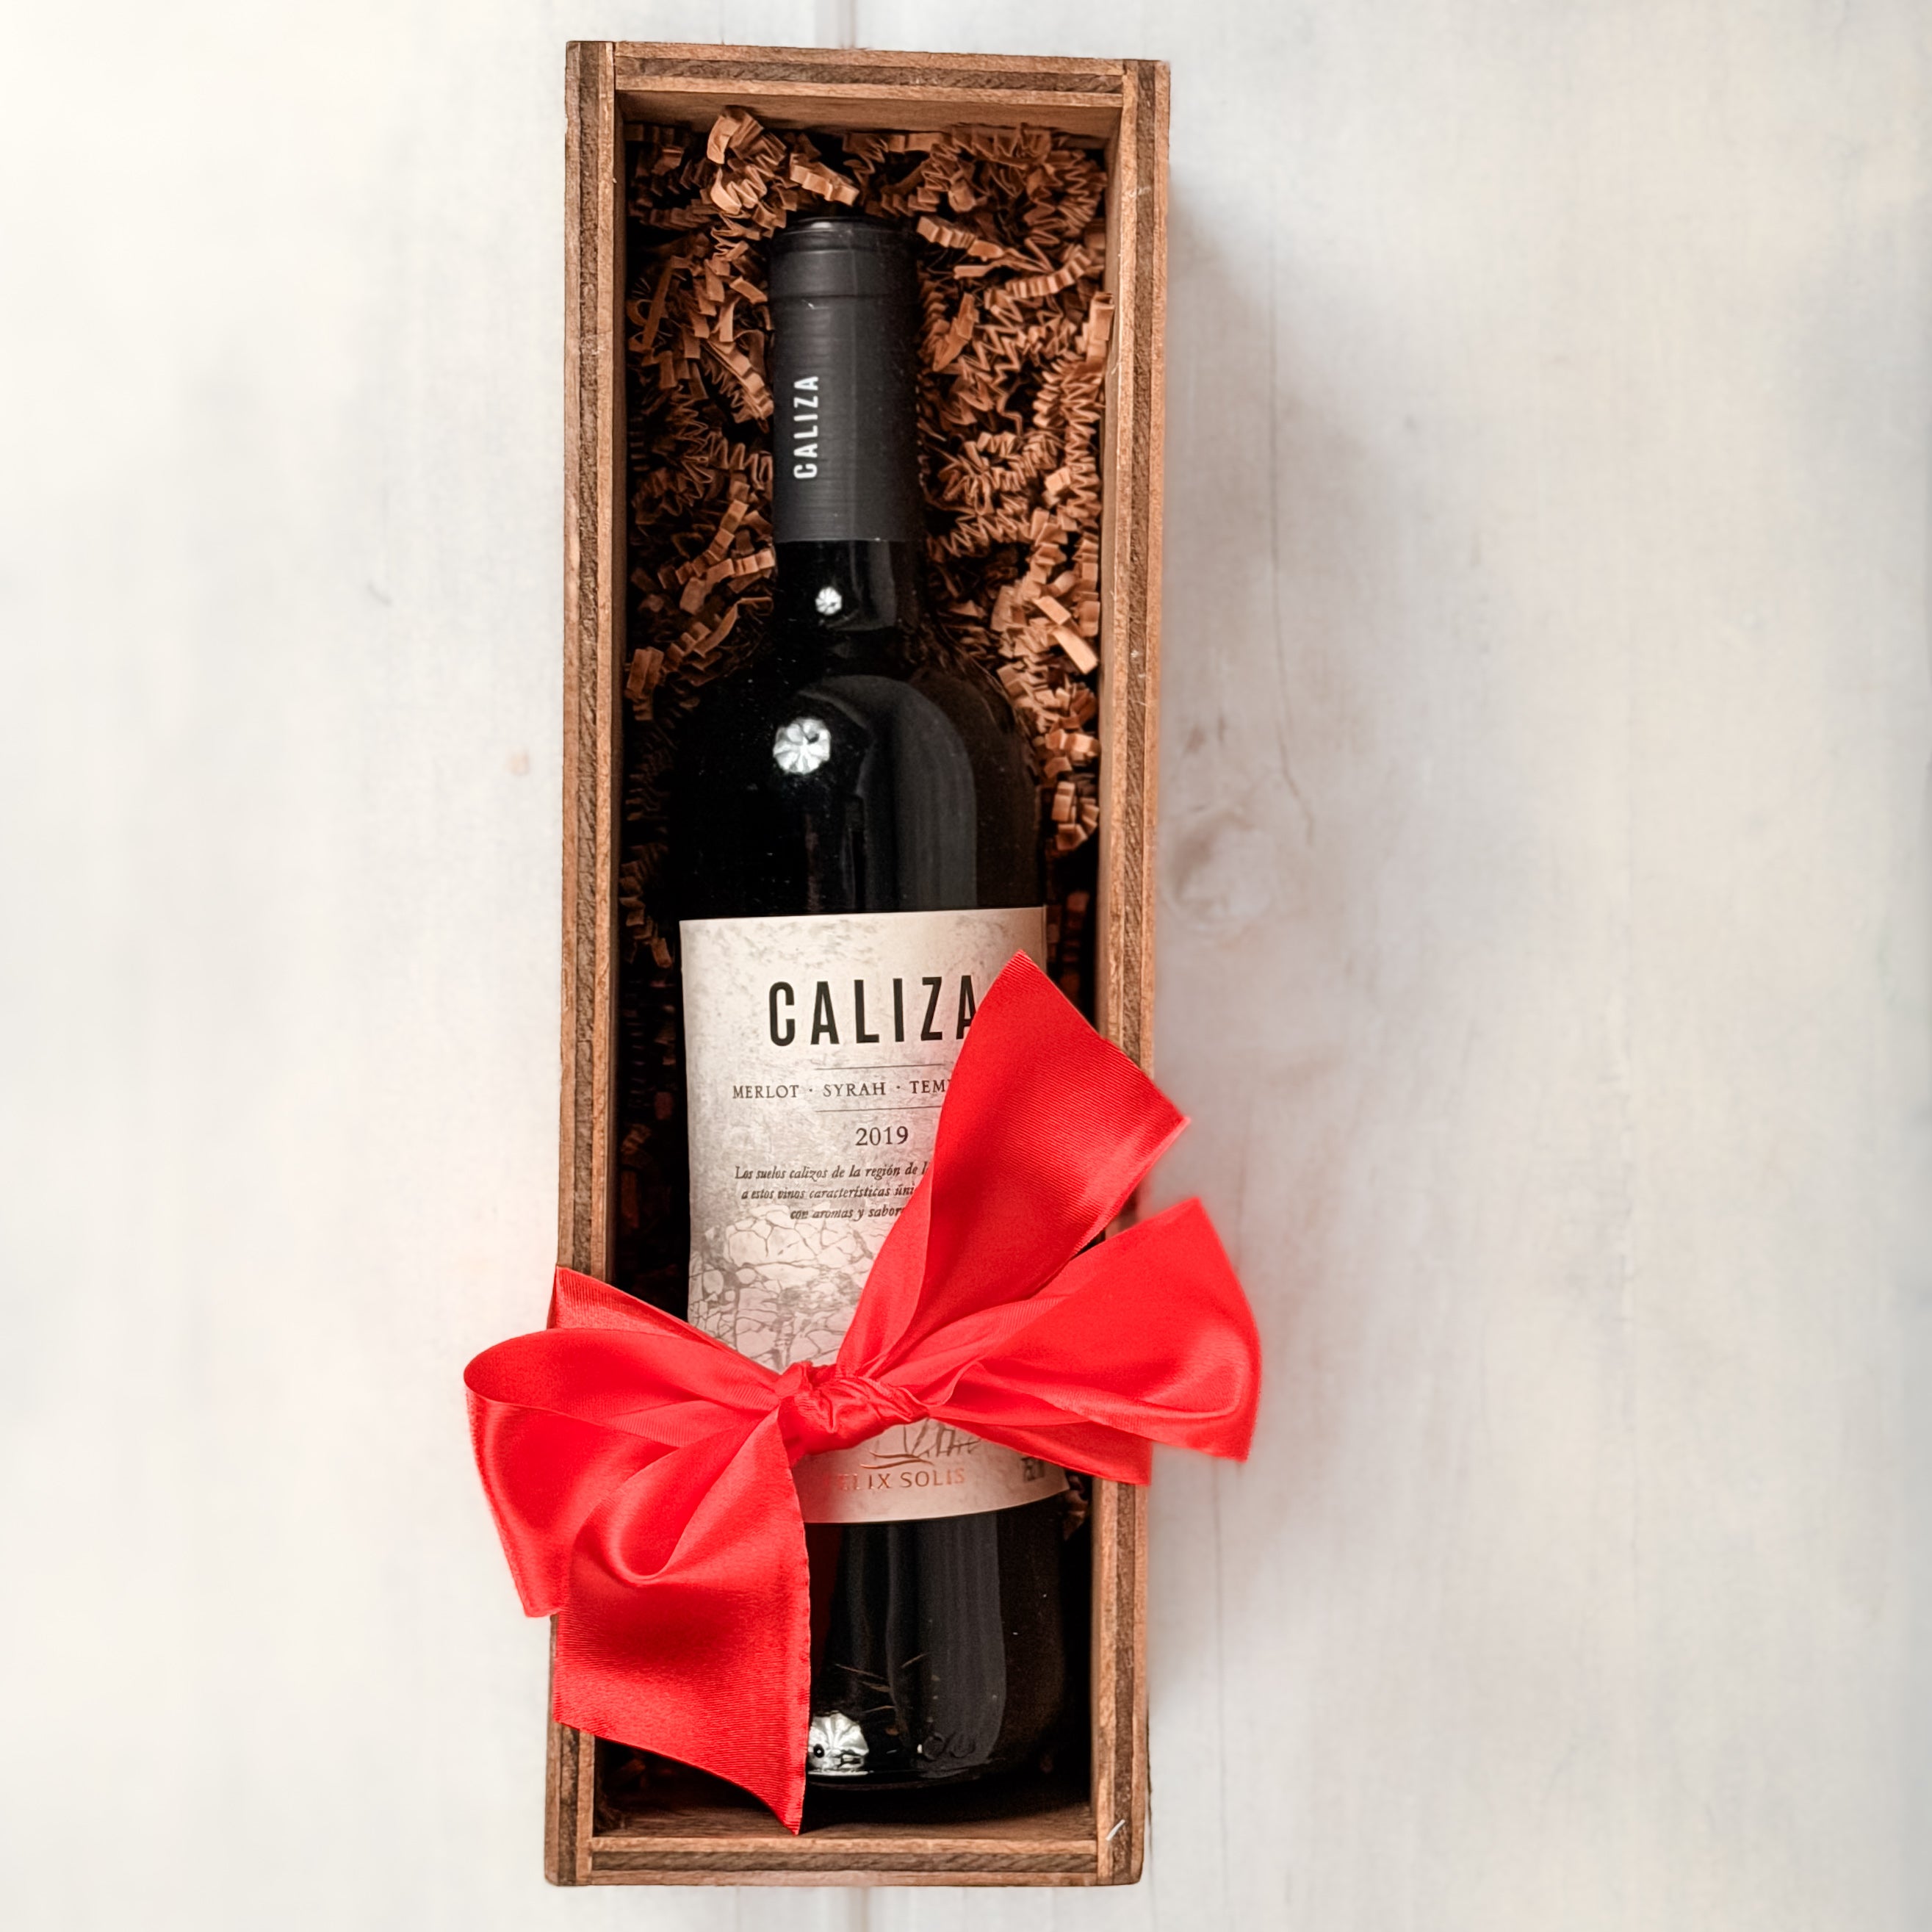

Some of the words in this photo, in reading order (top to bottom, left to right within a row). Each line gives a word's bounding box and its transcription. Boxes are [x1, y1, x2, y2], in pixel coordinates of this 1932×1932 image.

[793, 375, 819, 480] CALIZA
[768, 974, 978, 1047] CALIZA
[732, 1084, 799, 1100] MERLOT
[823, 1081, 887, 1097] SYRAH
[909, 1078, 951, 1095] TEM
[854, 1125, 909, 1147] 2019
[735, 1165, 754, 1180] Los
[755, 1166, 786, 1180] suelos
[789, 1164, 828, 1182] calizos
[832, 1164, 845, 1178] de
[849, 1164, 862, 1178] la
[865, 1162, 901, 1181] región
[904, 1161, 918, 1175] de
[740, 1189, 749, 1200] a
[751, 1186, 775, 1200] estos
[777, 1184, 805, 1200] vinos
[809, 1183, 890, 1199] características
[894, 1181, 915, 1196] úni
[790, 1209, 809, 1220] con
[812, 1207, 854, 1220] aromas
[857, 1208, 865, 1221] y
[899, 1467, 966, 1489] SOLIS
